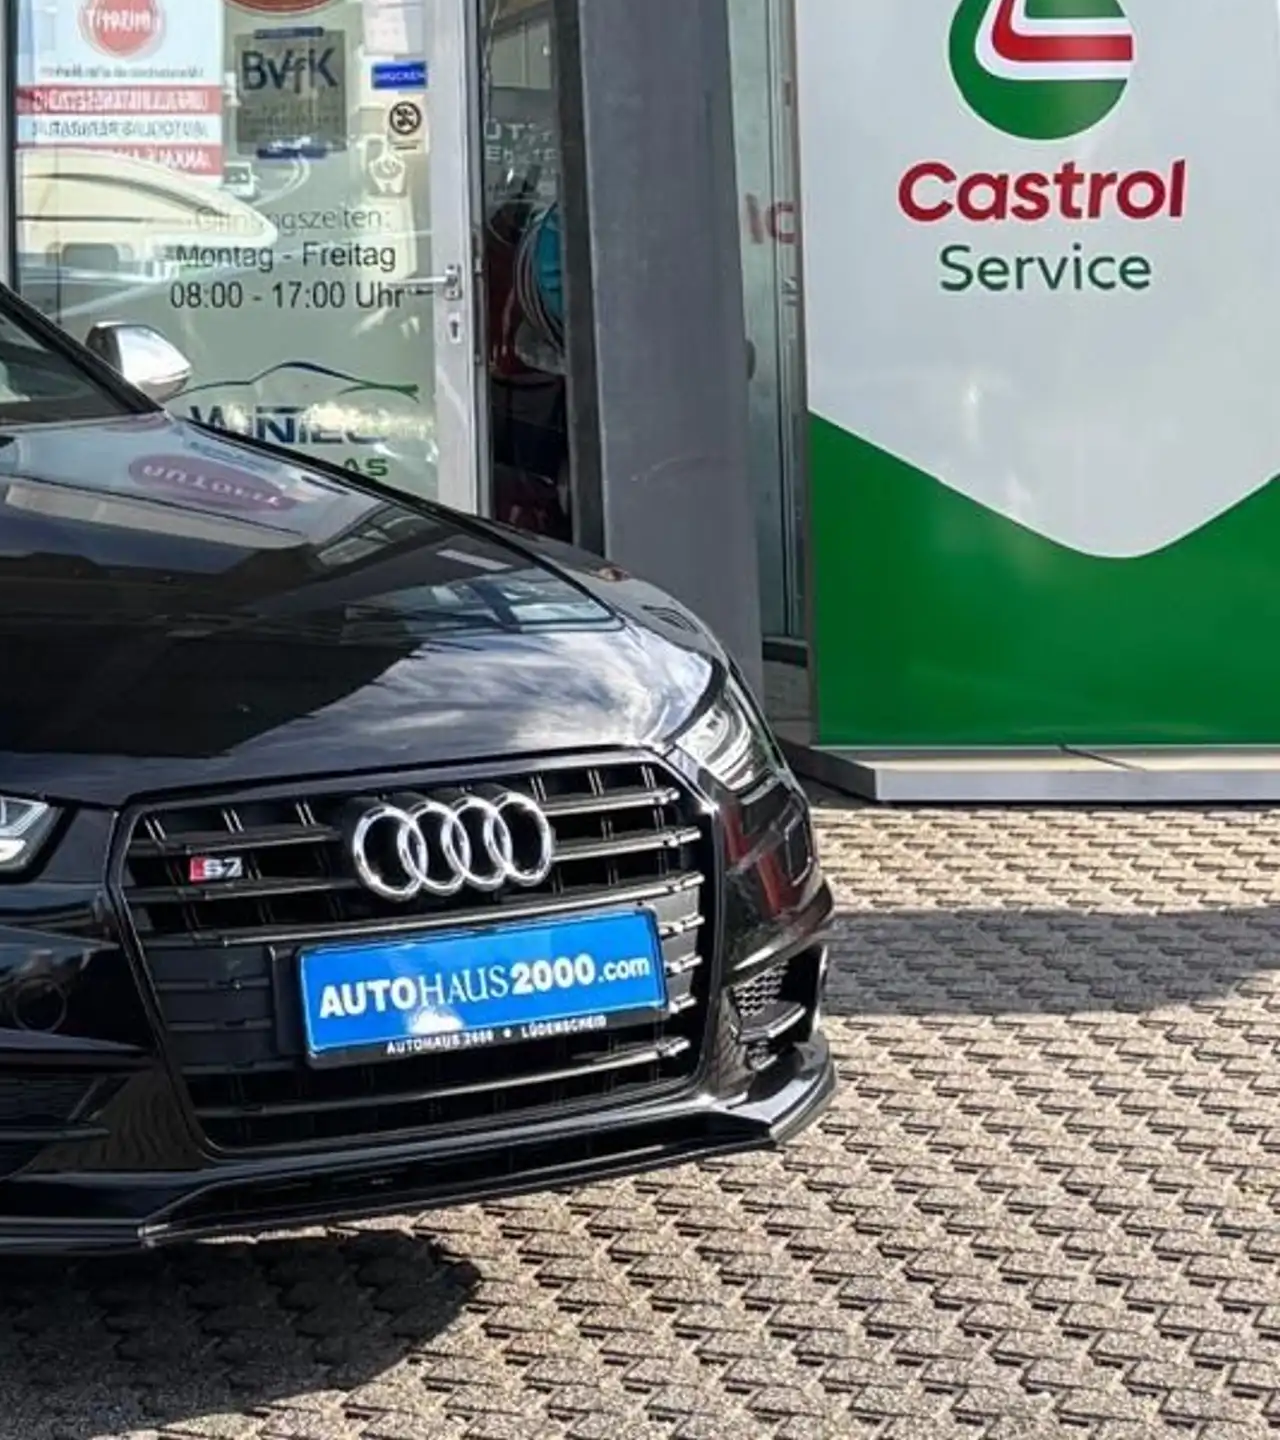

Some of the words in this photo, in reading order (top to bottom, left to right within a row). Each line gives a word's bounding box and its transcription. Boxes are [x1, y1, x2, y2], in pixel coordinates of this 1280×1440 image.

[898, 159, 1186, 222] Castrol
[176, 244, 274, 273] Montag
[302, 241, 397, 273] Freitag
[939, 242, 1153, 291] Service
[170, 280, 244, 309] 08:00
[272, 280, 346, 308] 17:00
[355, 281, 406, 309] Uhr
[319, 953, 651, 1018] AUTOHAUS2000.com
[386, 1034, 460, 1055] AUTOHAUS
